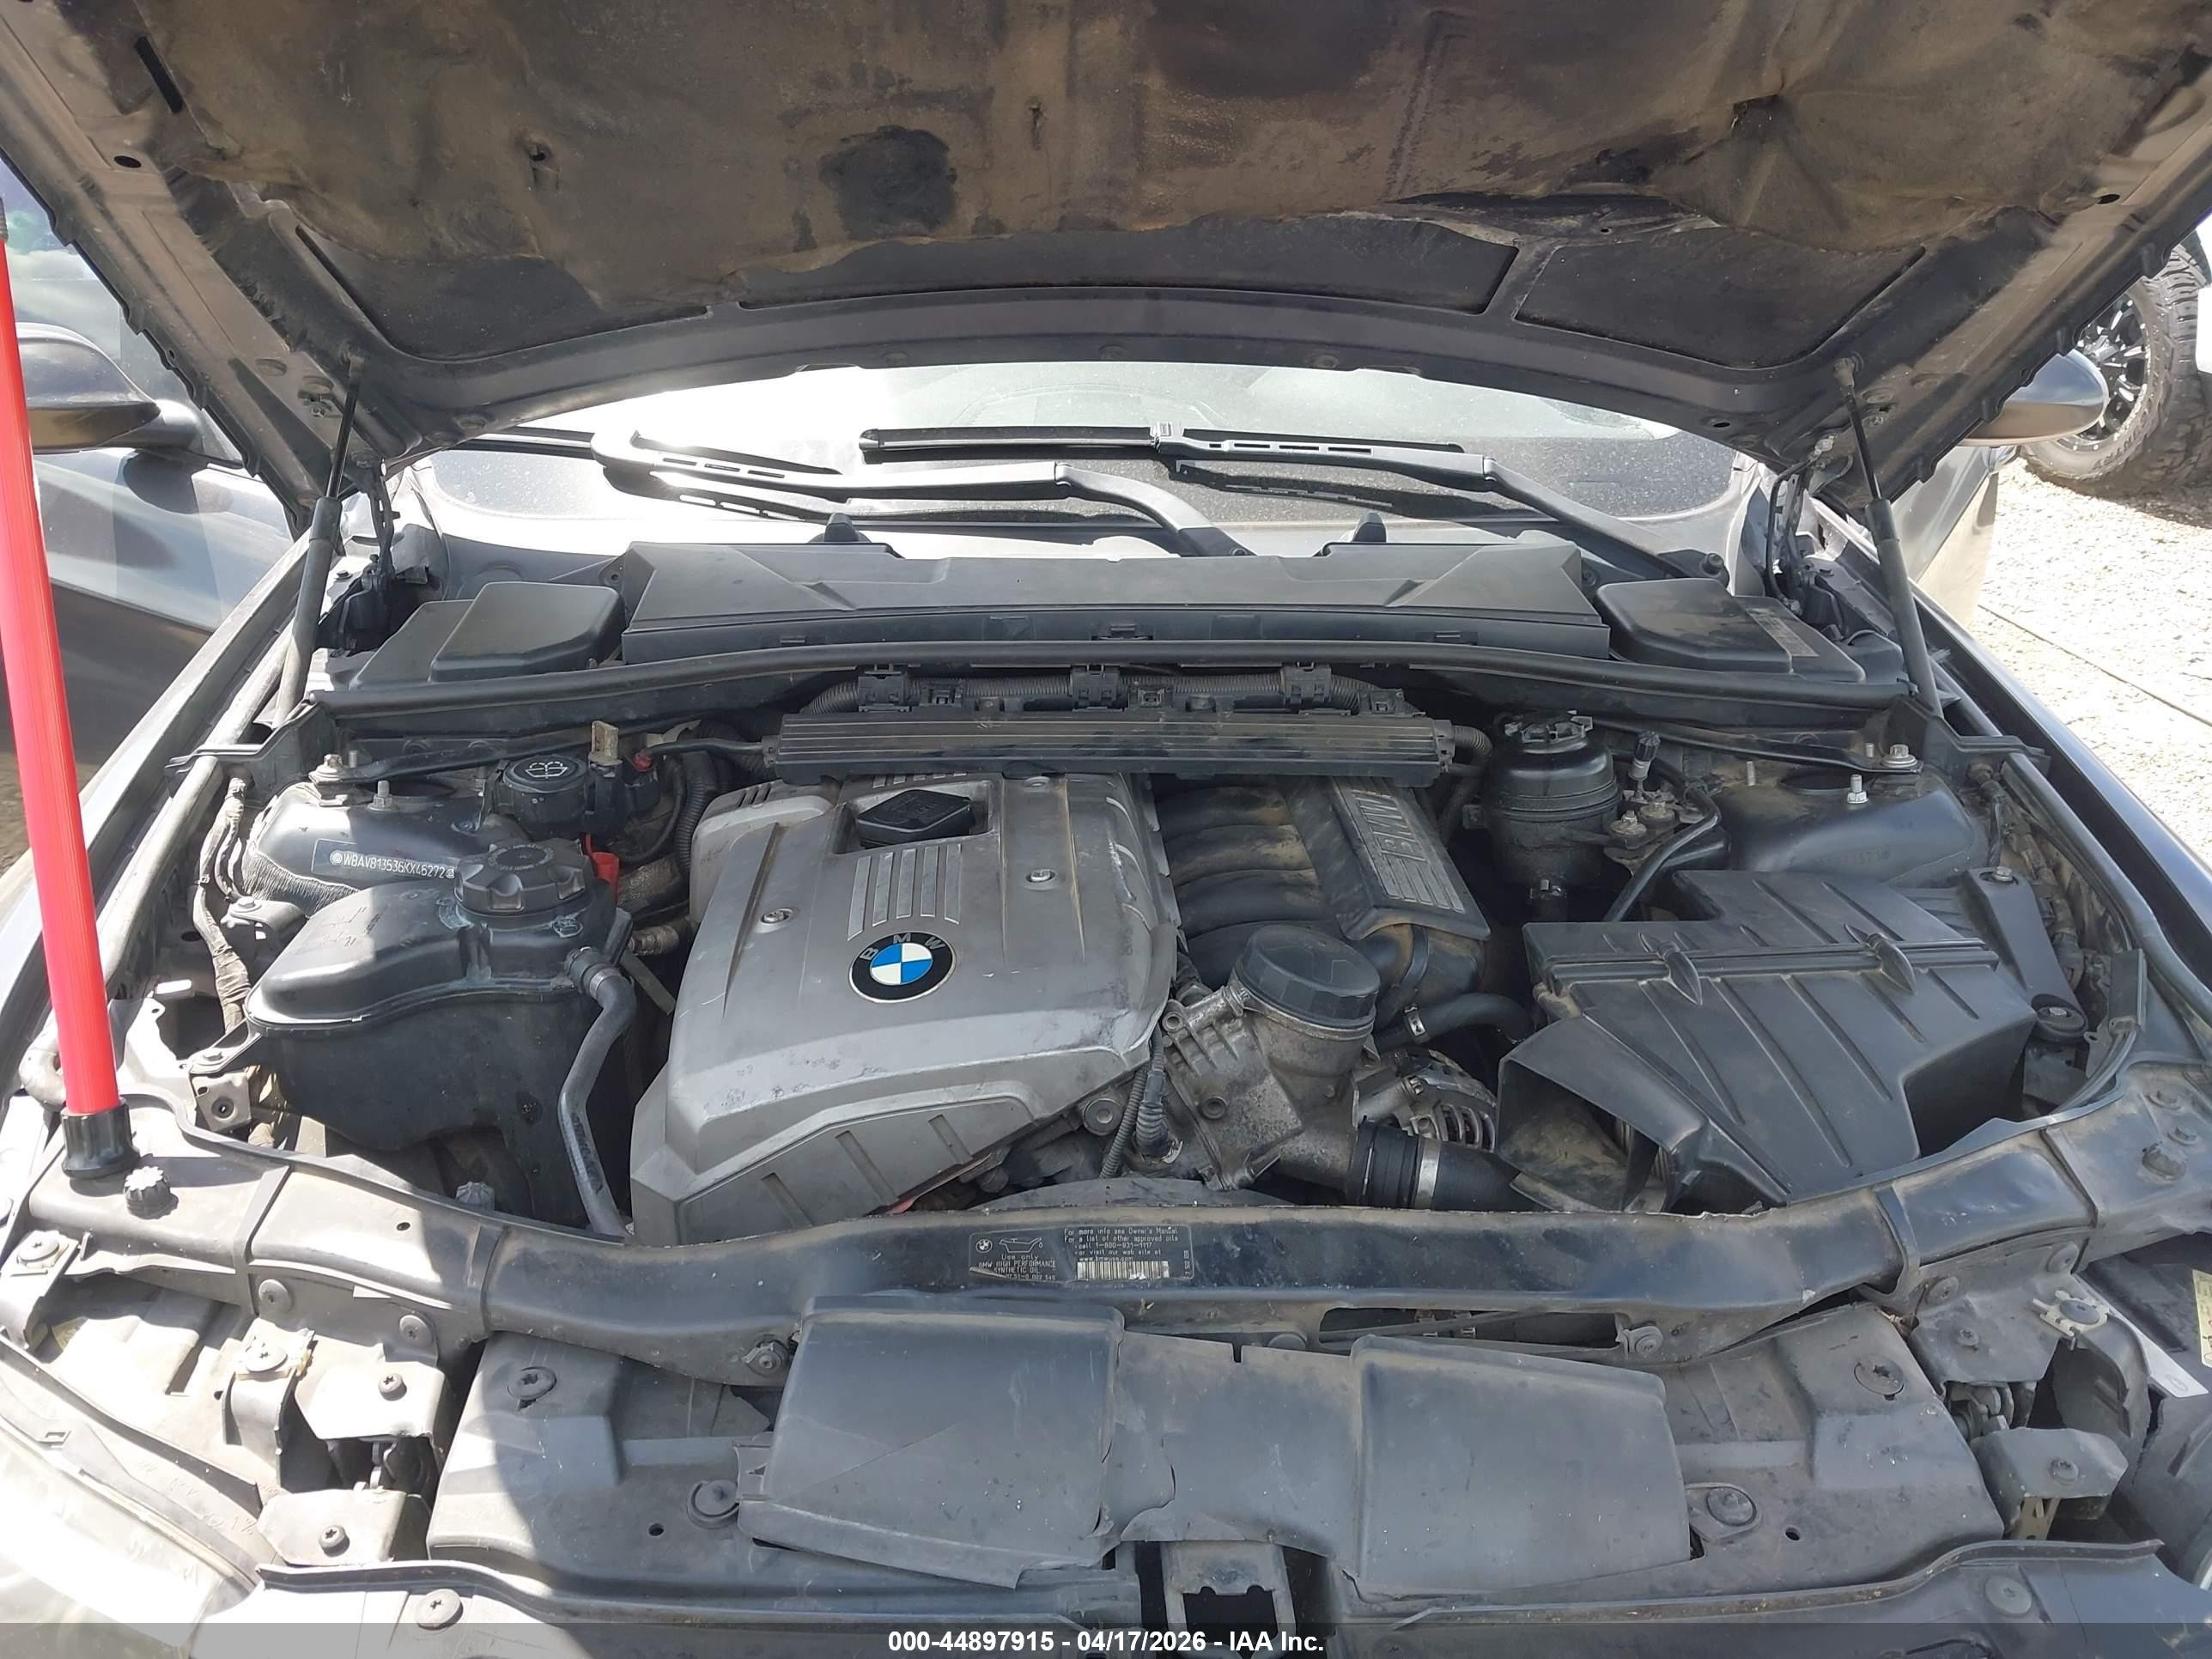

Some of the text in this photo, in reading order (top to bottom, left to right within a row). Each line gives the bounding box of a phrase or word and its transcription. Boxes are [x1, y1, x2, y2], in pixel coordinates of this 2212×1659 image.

[859, 933, 946, 961] BMW
[1128, 1226, 1152, 1235] Owner's
[1156, 1226, 1178, 1235] Manual
[1064, 1235, 1075, 1243] For
[1133, 1235, 1163, 1243] approved
[1020, 1253, 1039, 1261] only
[1013, 1260, 1056, 1268] PERFORMANCE
